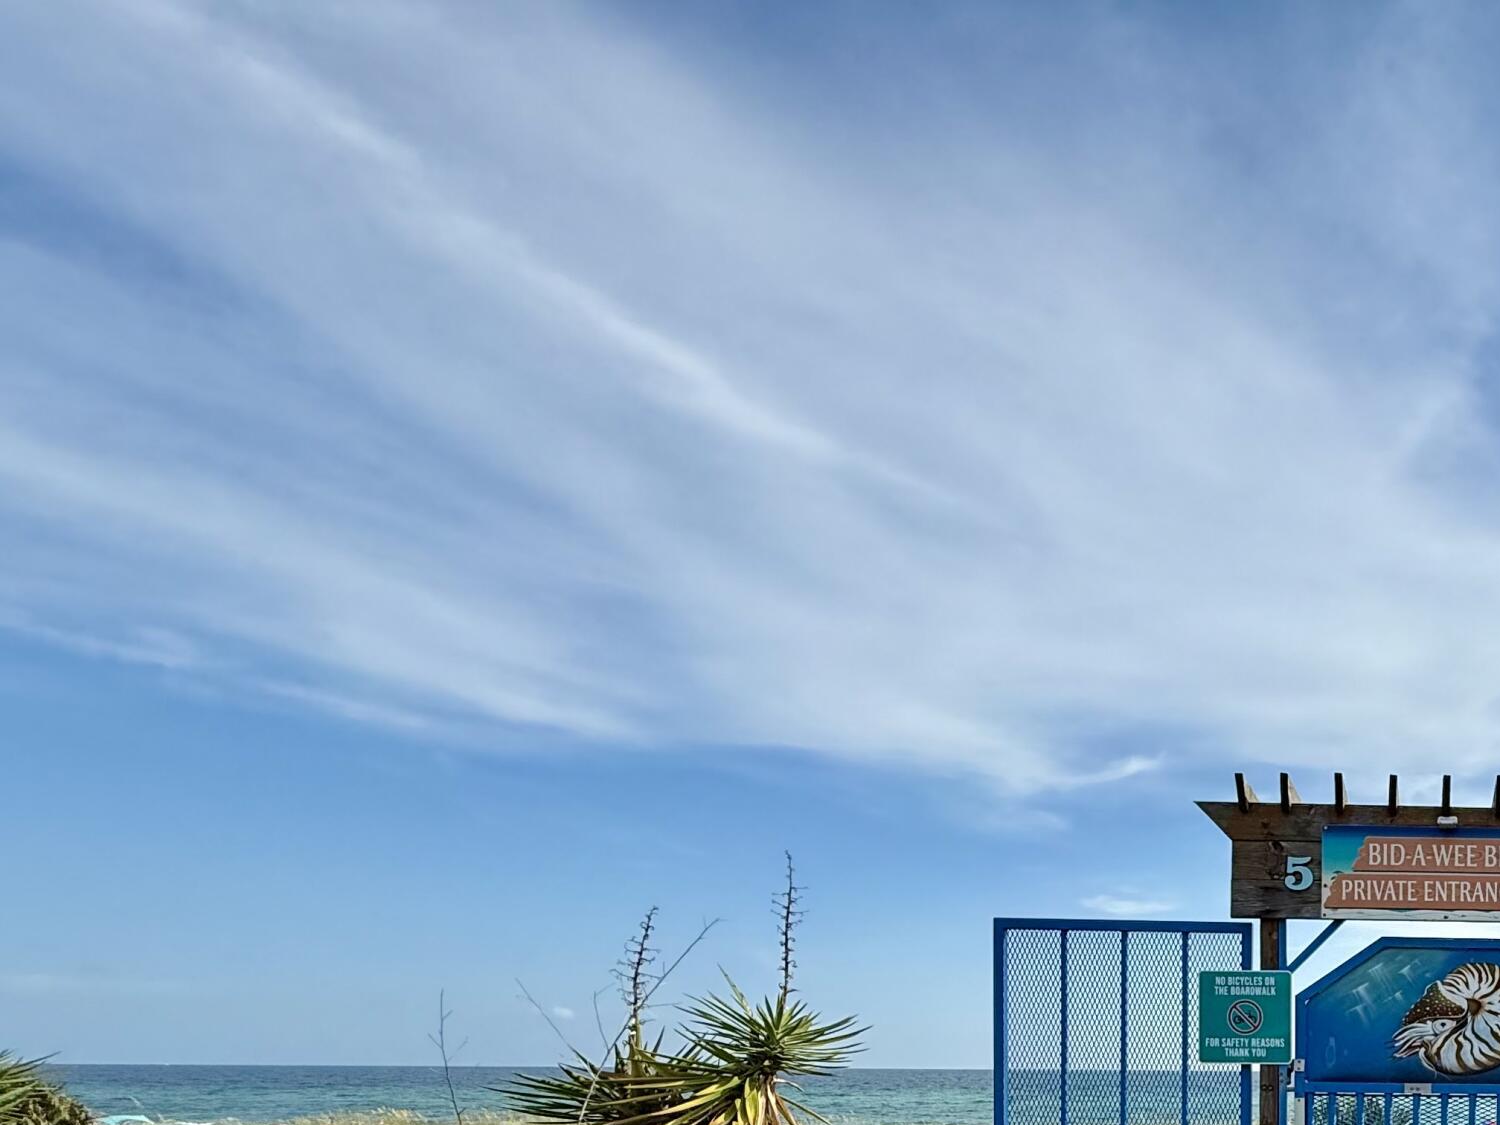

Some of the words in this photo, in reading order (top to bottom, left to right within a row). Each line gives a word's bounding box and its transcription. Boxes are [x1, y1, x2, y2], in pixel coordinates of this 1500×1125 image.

[1368, 843, 1478, 868] BID-A-WEE
[1284, 856, 1314, 890] 5
[1341, 880, 1417, 901] PRIVATE
[1215, 976, 1226, 985] NO
[1228, 977, 1262, 985] BICYCLES
[1265, 977, 1275, 985] ON
[1214, 986, 1229, 995] THE
[1231, 986, 1276, 996] BOARDWALK
[1205, 1038, 1219, 1047] FOR
[1221, 1038, 1249, 1047] SAFETY
[1251, 1038, 1284, 1047] REASONS
[1225, 1048, 1249, 1057] THANK
[1252, 1048, 1266, 1057] YOU
